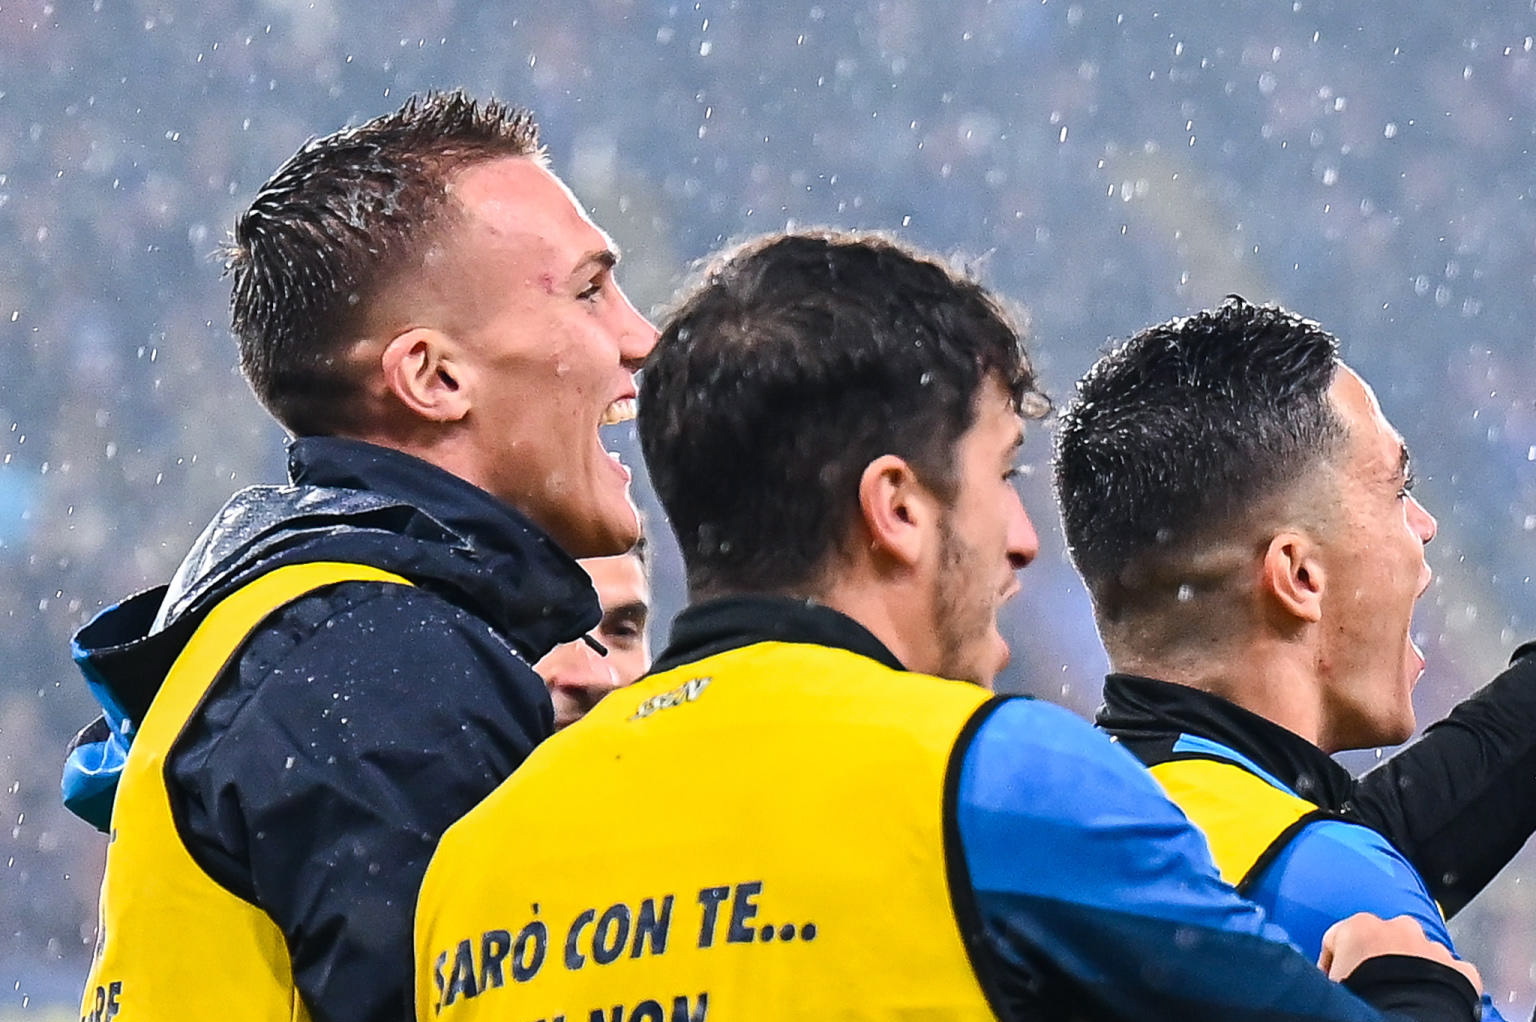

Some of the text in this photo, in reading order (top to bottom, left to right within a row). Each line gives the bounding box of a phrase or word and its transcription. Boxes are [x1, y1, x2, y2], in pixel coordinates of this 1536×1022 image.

[434, 881, 818, 1015] SARÒ CON TE...
